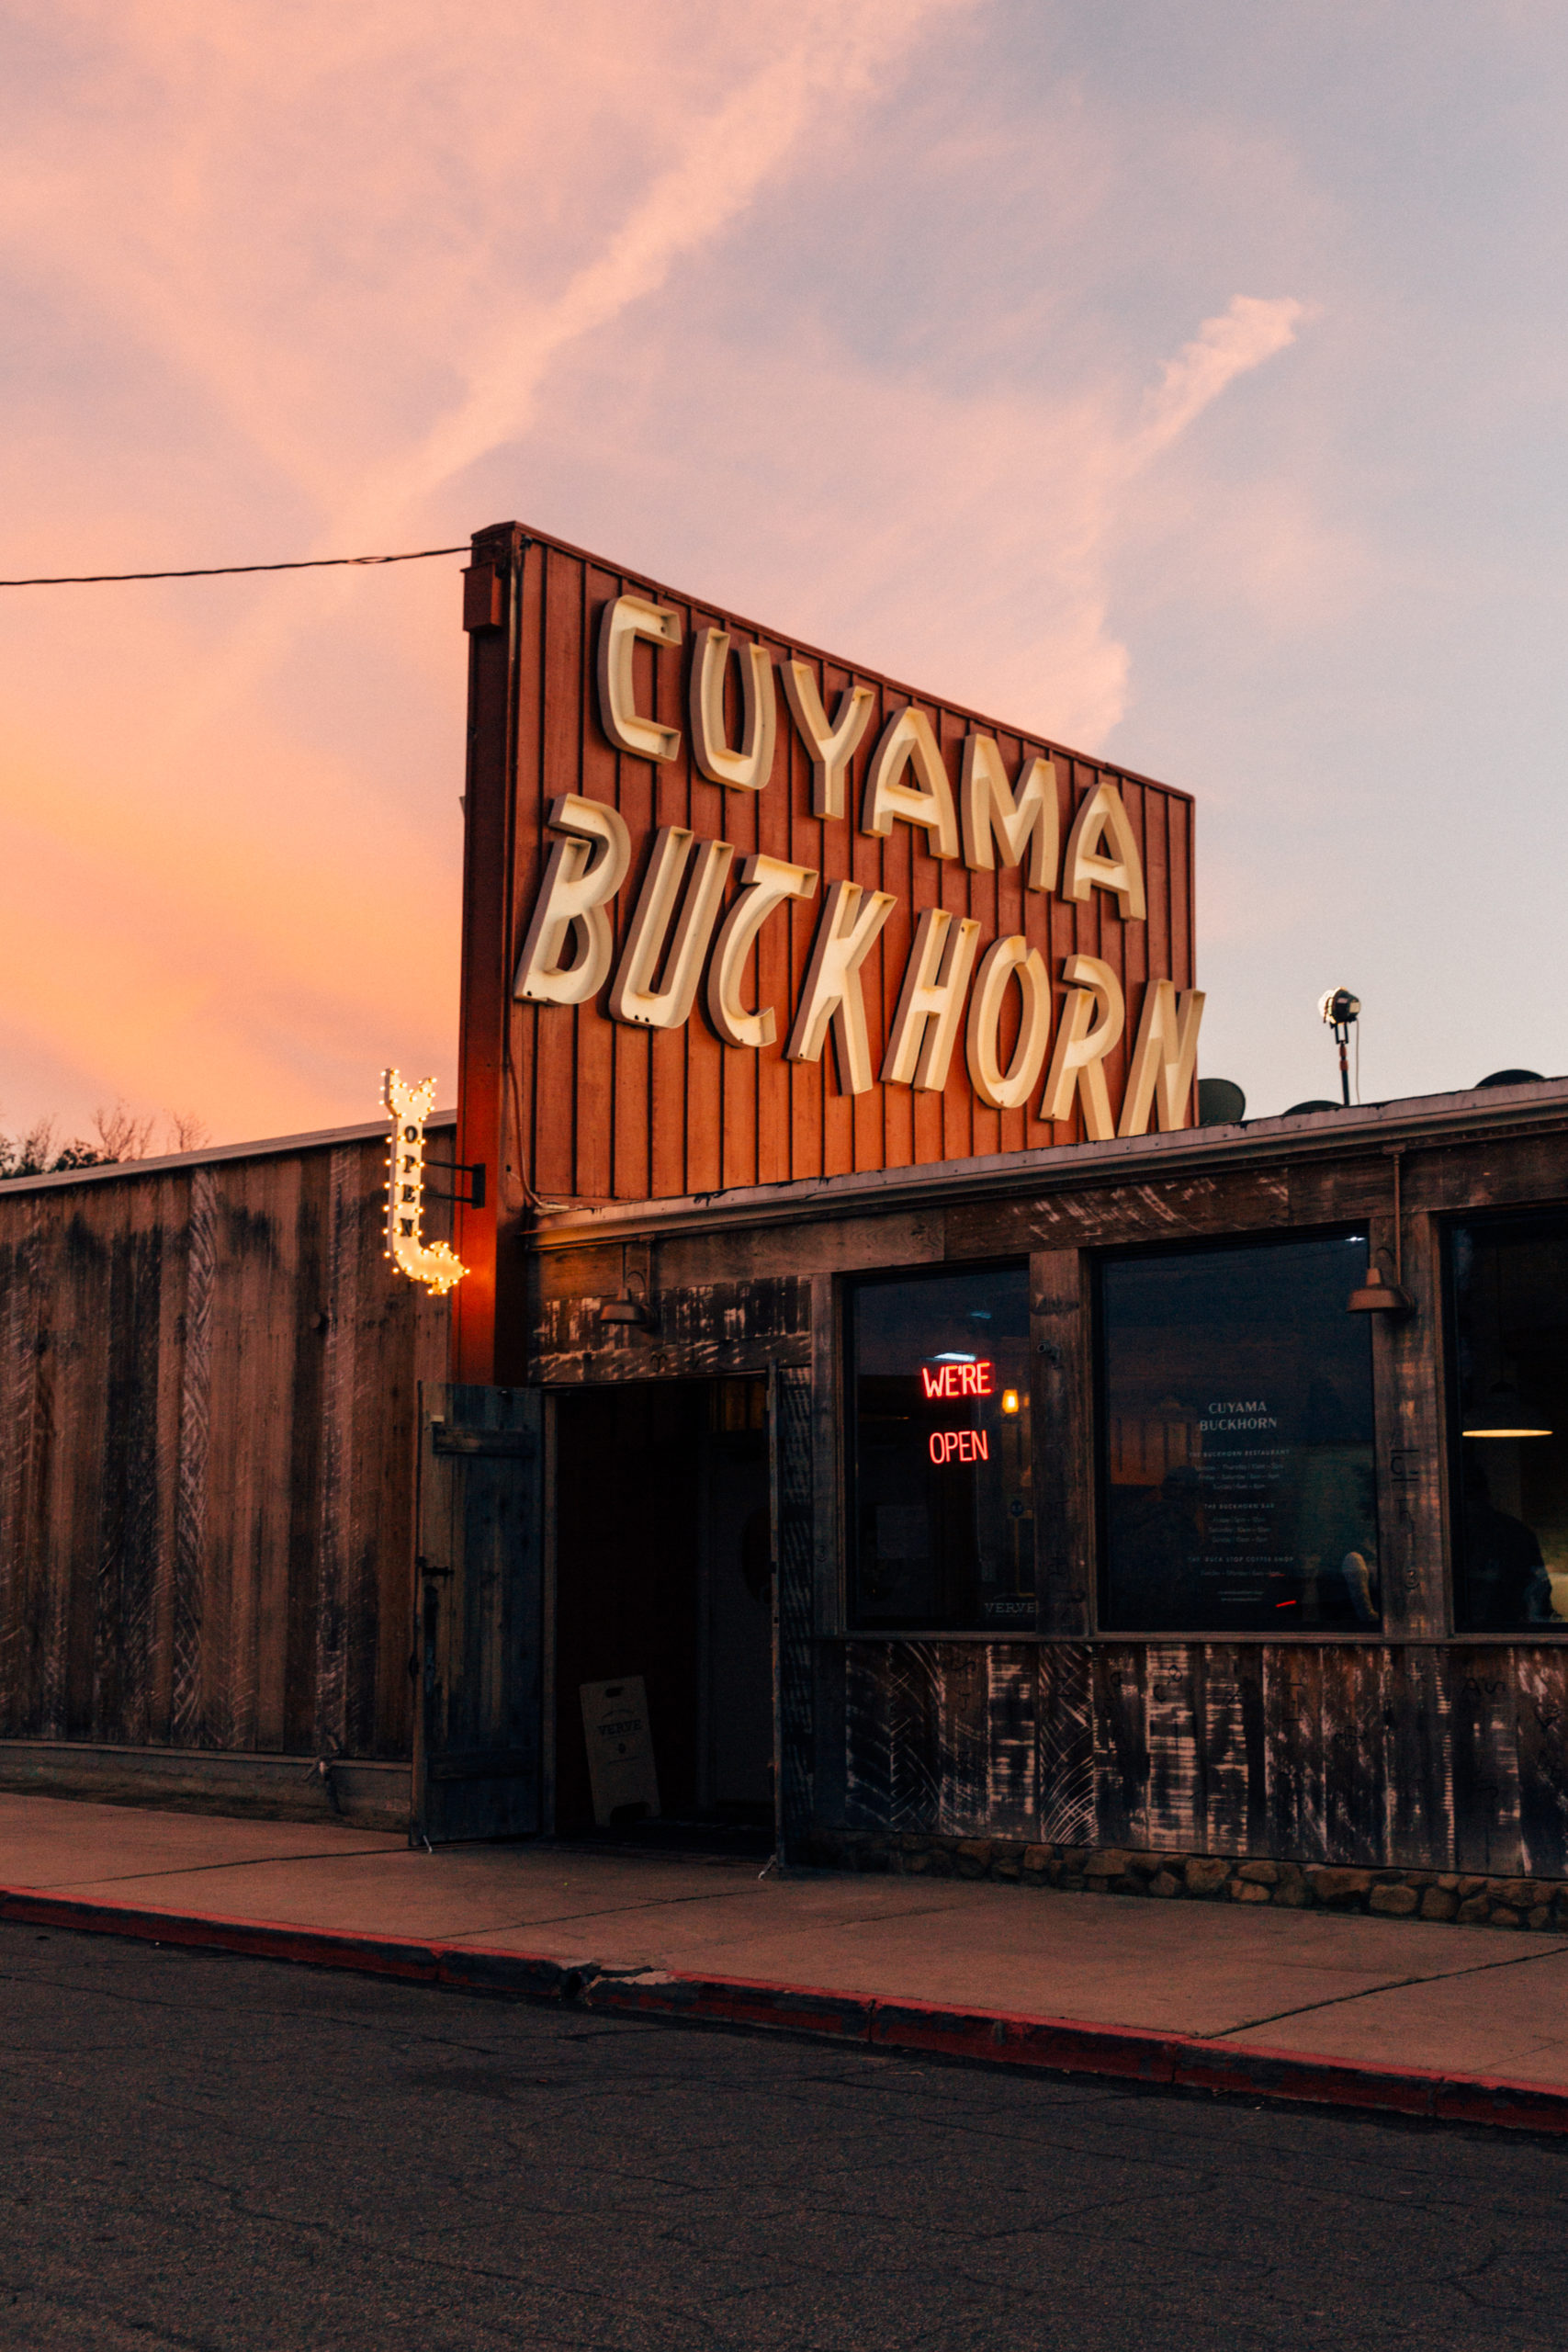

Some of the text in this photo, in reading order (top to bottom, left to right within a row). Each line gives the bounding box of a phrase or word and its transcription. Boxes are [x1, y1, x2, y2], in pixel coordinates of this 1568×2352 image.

[598, 594, 1146, 922] CUYAMA
[513, 793, 1206, 1142] BUCKHORN
[400, 1125, 418, 1237] OPEN
[922, 1363, 992, 1397] WE'RE
[1199, 1418, 1278, 1431] BUCKHORN
[1208, 1401, 1268, 1414] CUYAMA
[929, 1430, 988, 1464] OPEN
[984, 1602, 1036, 1613] VERVE
[597, 1719, 642, 1736] VERVE
